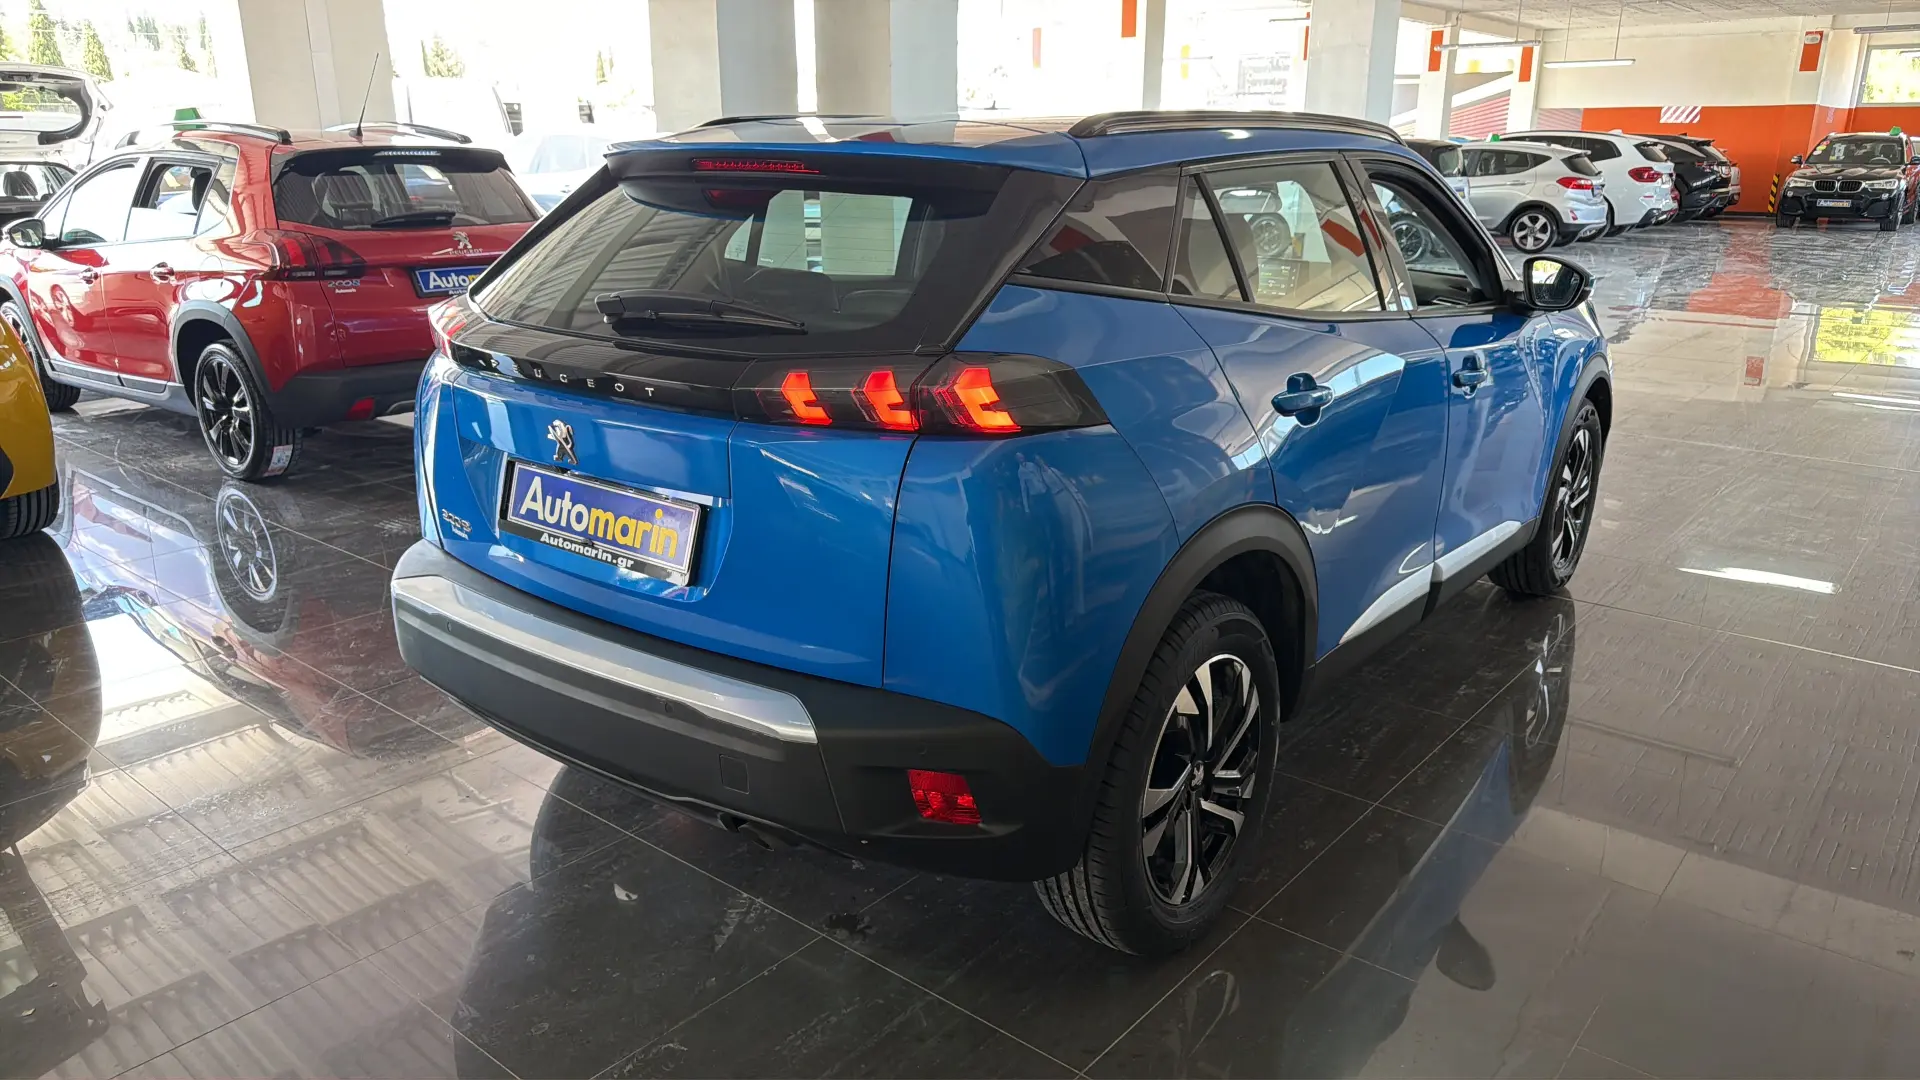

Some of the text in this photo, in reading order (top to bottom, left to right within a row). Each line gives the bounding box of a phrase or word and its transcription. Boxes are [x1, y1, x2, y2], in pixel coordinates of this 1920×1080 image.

[490, 358, 655, 397] PEUGEOT
[519, 475, 679, 558] Automarin
[539, 532, 635, 569] Automarin.gr
